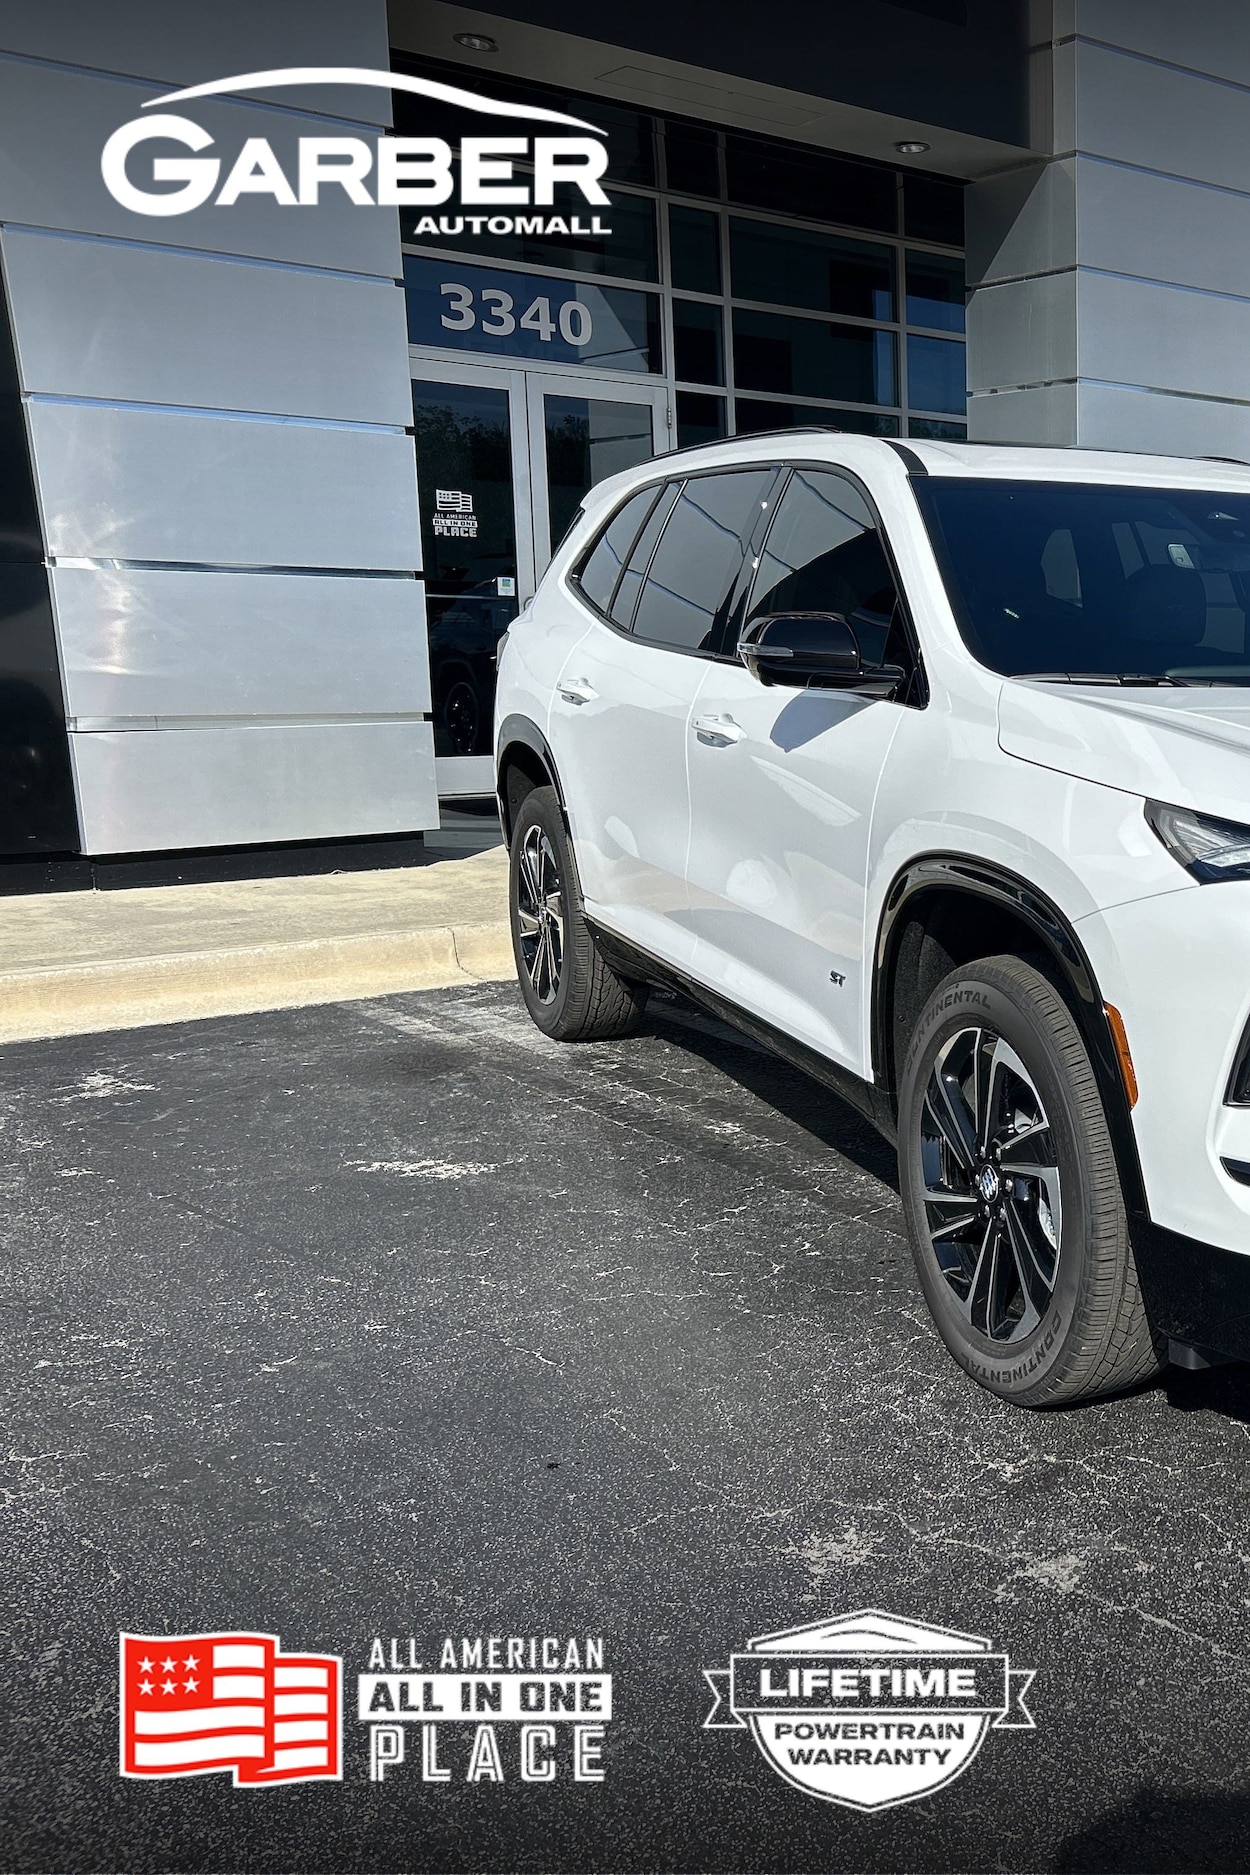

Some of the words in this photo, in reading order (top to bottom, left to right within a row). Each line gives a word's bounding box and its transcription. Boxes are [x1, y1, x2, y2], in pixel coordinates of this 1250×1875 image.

[439, 283, 594, 346] 3340
[434, 526, 478, 538] PLACE
[829, 970, 846, 988] ST
[961, 1310, 1062, 1384] CONTINENTAL
